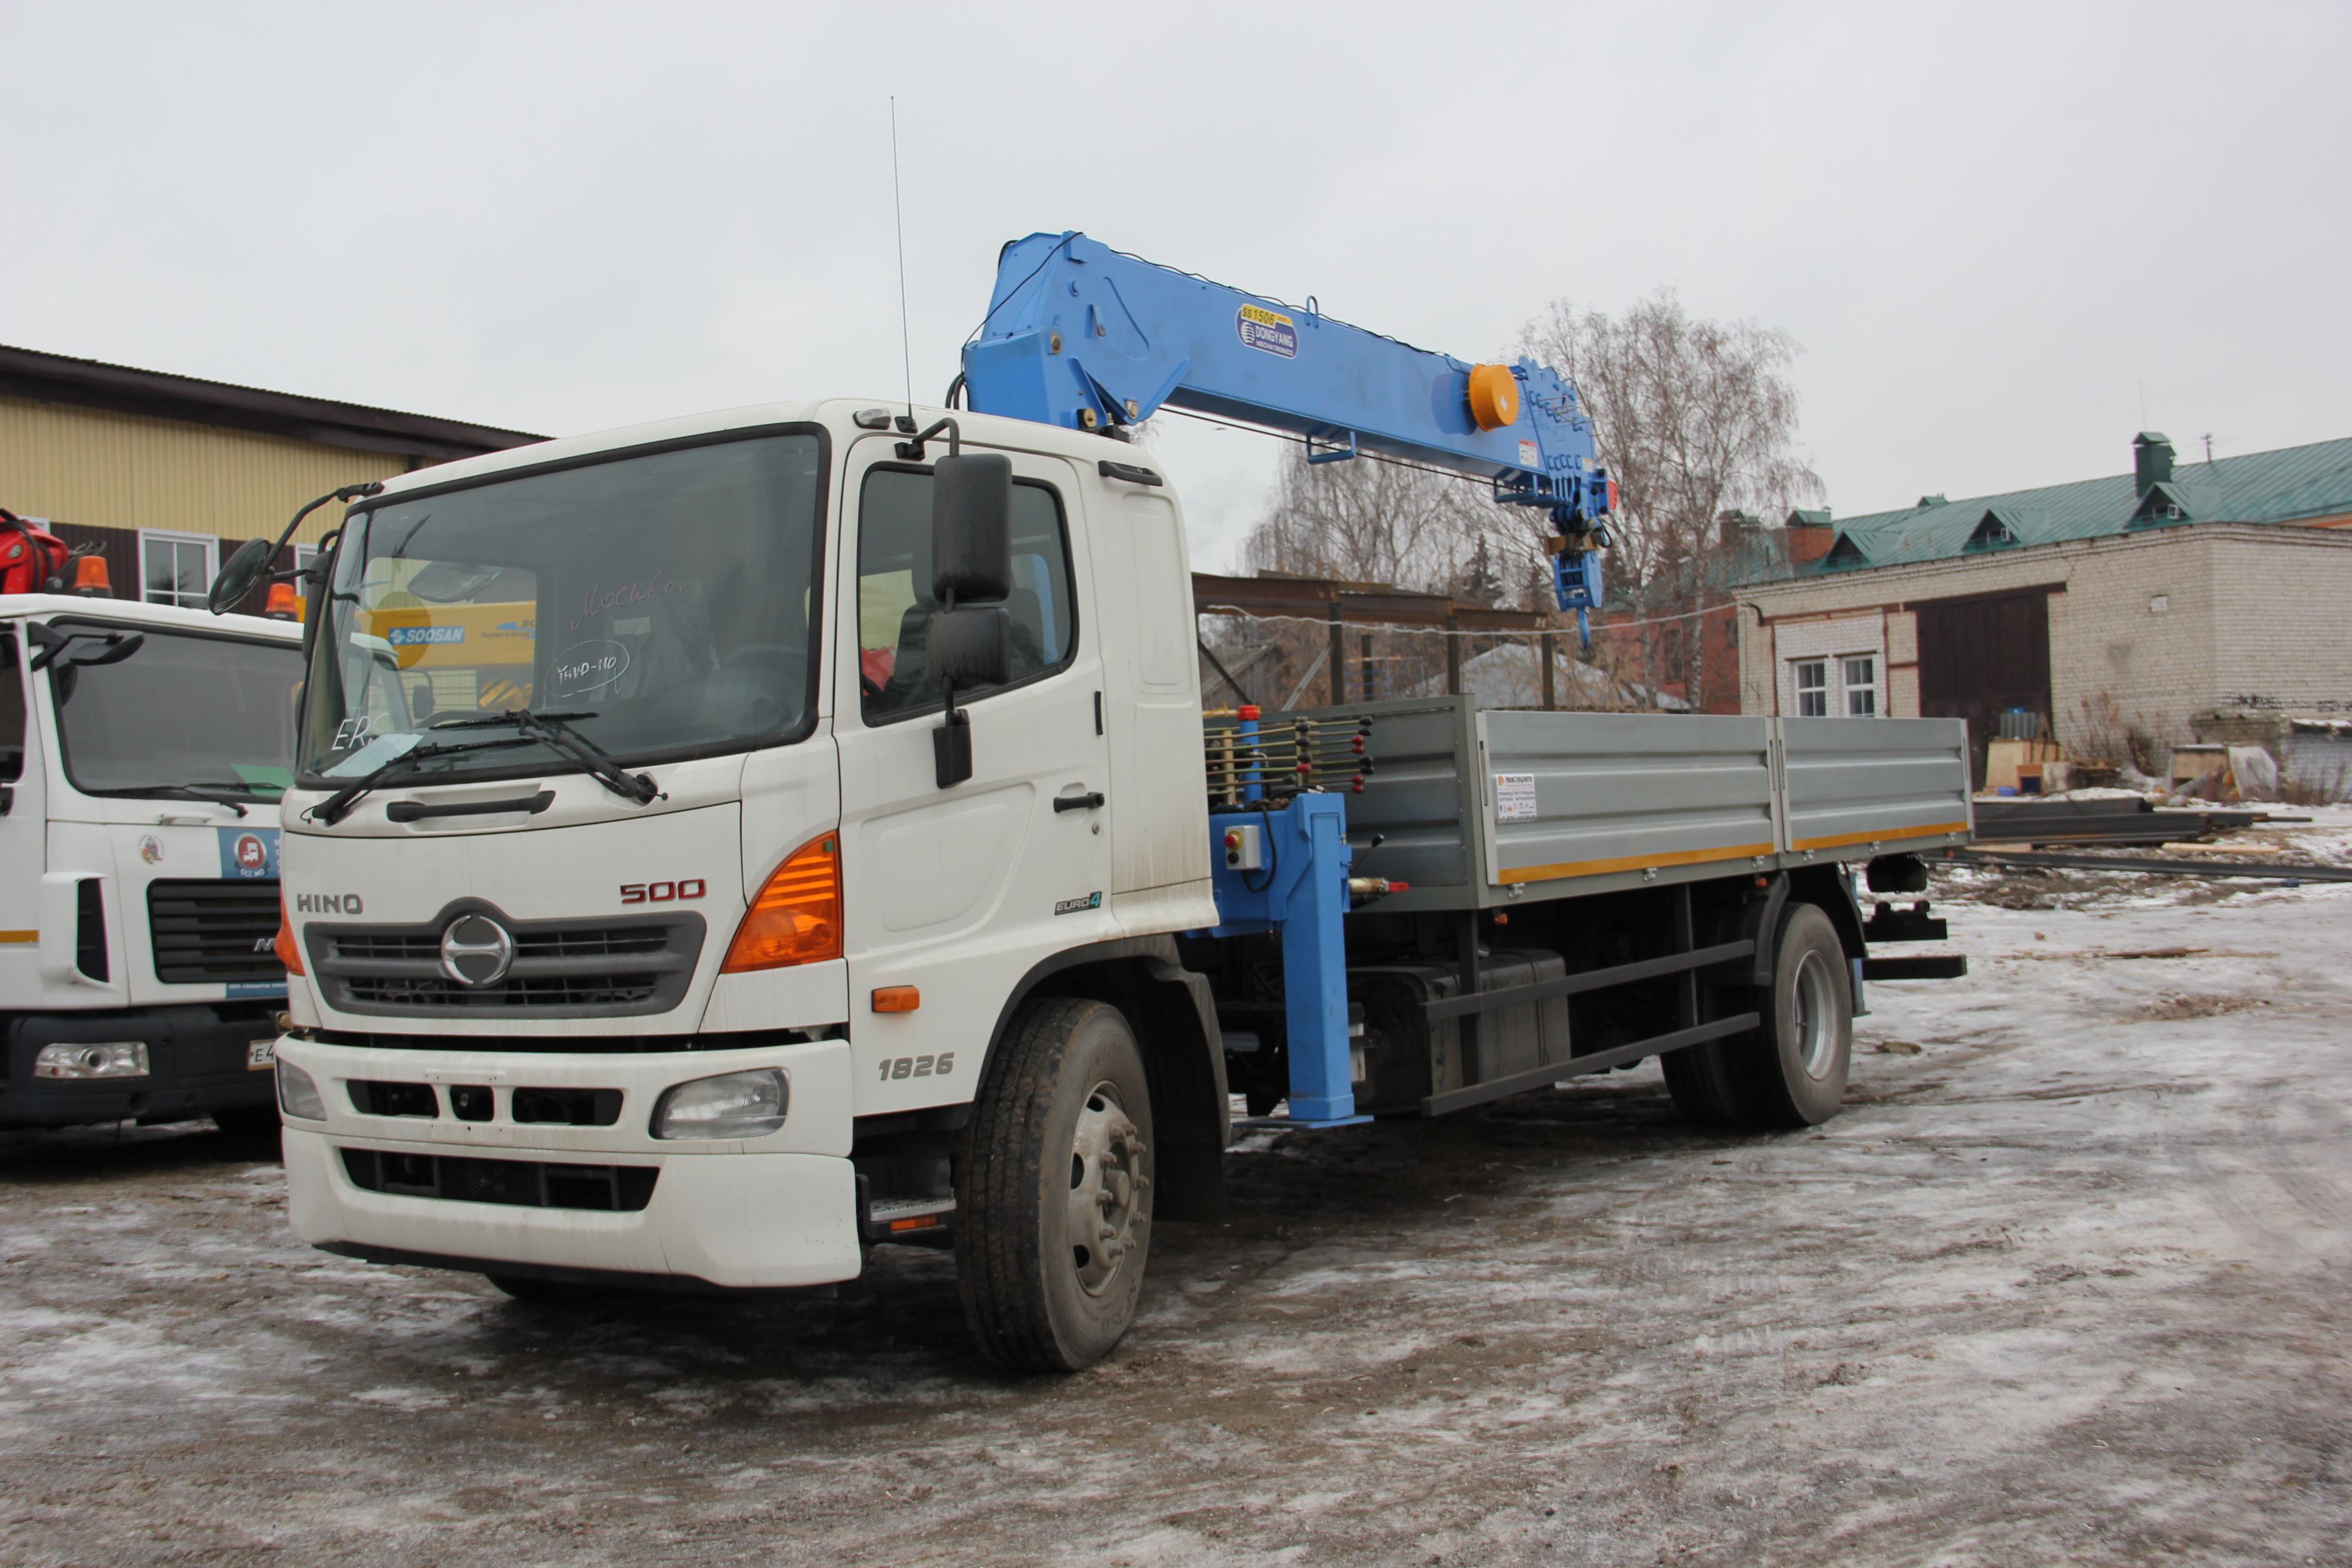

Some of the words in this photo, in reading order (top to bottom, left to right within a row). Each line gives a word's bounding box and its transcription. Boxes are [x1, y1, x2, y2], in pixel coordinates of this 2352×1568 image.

[1242, 308, 1252, 318] SS
[1254, 309, 1275, 325] 1506
[1255, 325, 1294, 348] DONGYANG
[406, 627, 464, 643] SOOSAN
[620, 879, 707, 904] 500
[297, 893, 363, 915] HINO
[879, 1052, 955, 1081] 1826
